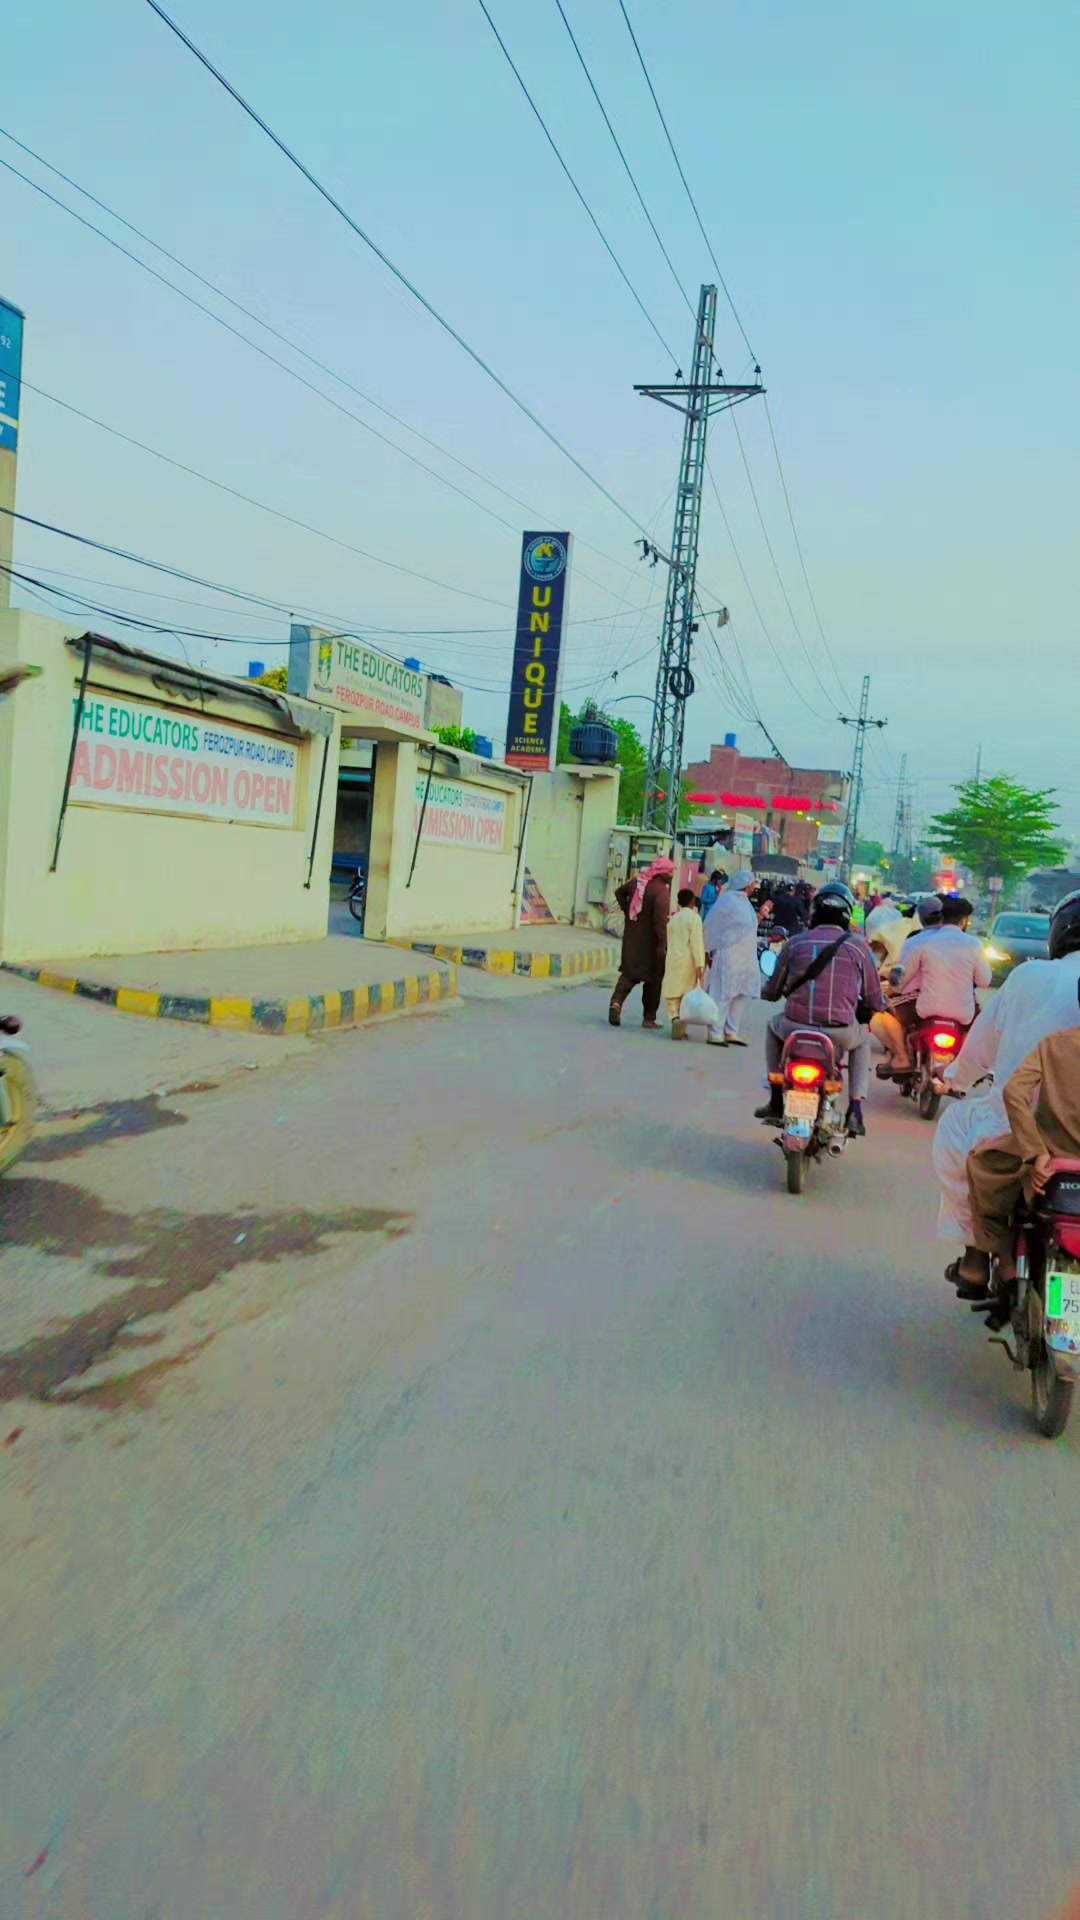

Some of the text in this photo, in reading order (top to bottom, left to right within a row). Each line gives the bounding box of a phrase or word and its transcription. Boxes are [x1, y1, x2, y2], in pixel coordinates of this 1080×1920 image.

[337, 641, 359, 673] THE
[362, 652, 423, 698] EDUCATORS
[523, 586, 552, 734] UNIQUE
[72, 698, 199, 752] THE EDUCATORS
[336, 685, 374, 713] FEROZPUR
[375, 699, 393, 719] ROAD
[395, 707, 421, 729] CAMPUS
[203, 731, 294, 768] FEROZPUR ROAD CAMPUS
[510, 745, 546, 753] ACADEMY
[514, 737, 544, 745] SCIENCE
[70, 740, 291, 816] ADMISSION OPEN
[426, 783, 463, 807] DUCATORS
[476, 816, 503, 845] OPEN
